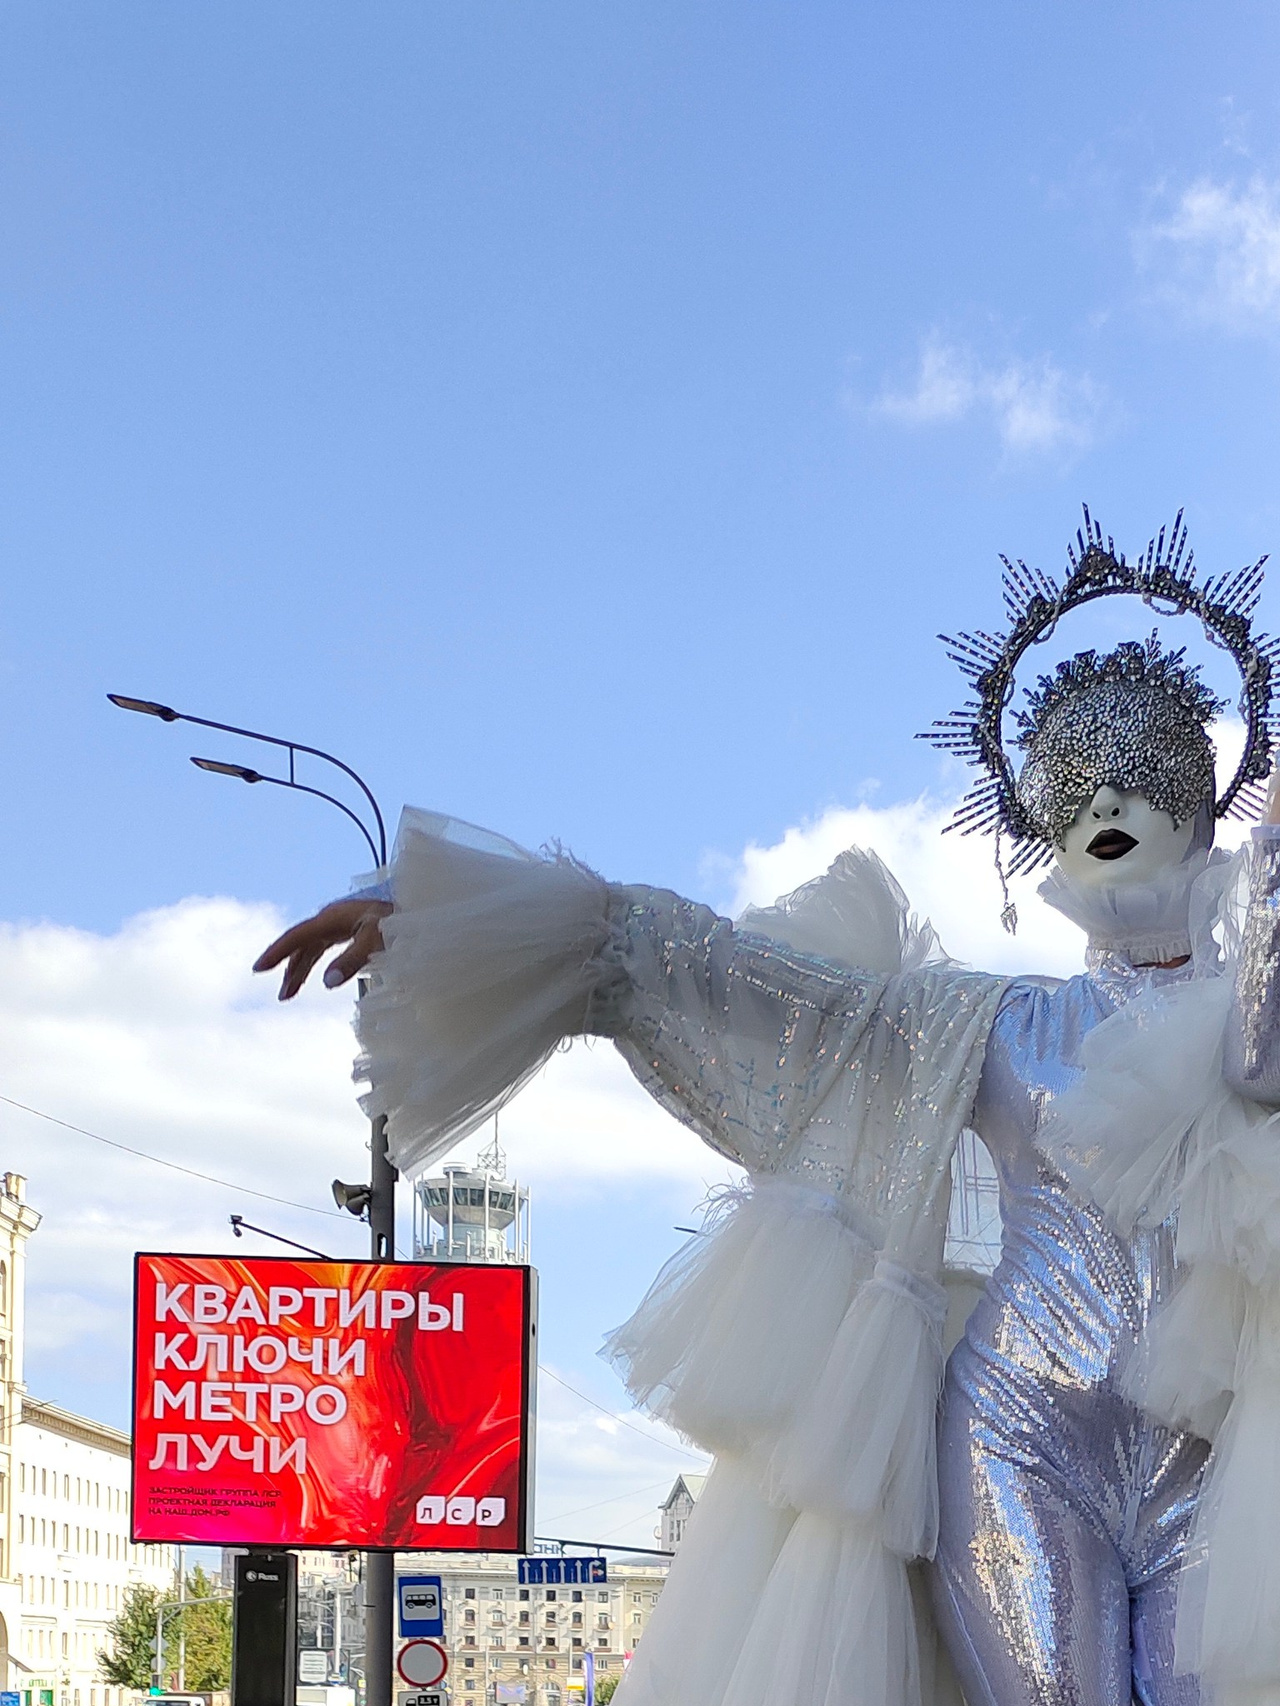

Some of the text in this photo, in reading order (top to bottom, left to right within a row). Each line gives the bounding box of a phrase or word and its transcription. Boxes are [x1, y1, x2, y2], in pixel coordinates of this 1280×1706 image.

[155, 1282, 464, 1332] КВАРТИРЫ
[154, 1332, 366, 1376] КЛЮЧИ
[154, 1380, 347, 1426] МЕТРО
[148, 1433, 307, 1475] ЛУЧИ
[148, 1497, 276, 1508] ПРОЕКТНАЯ ДЕКЛАРАЦИЯ
[148, 1507, 162, 1515] НА
[149, 1486, 217, 1496] ЗАСТРОЙЩИК
[221, 1488, 259, 1497] ГРУППА
